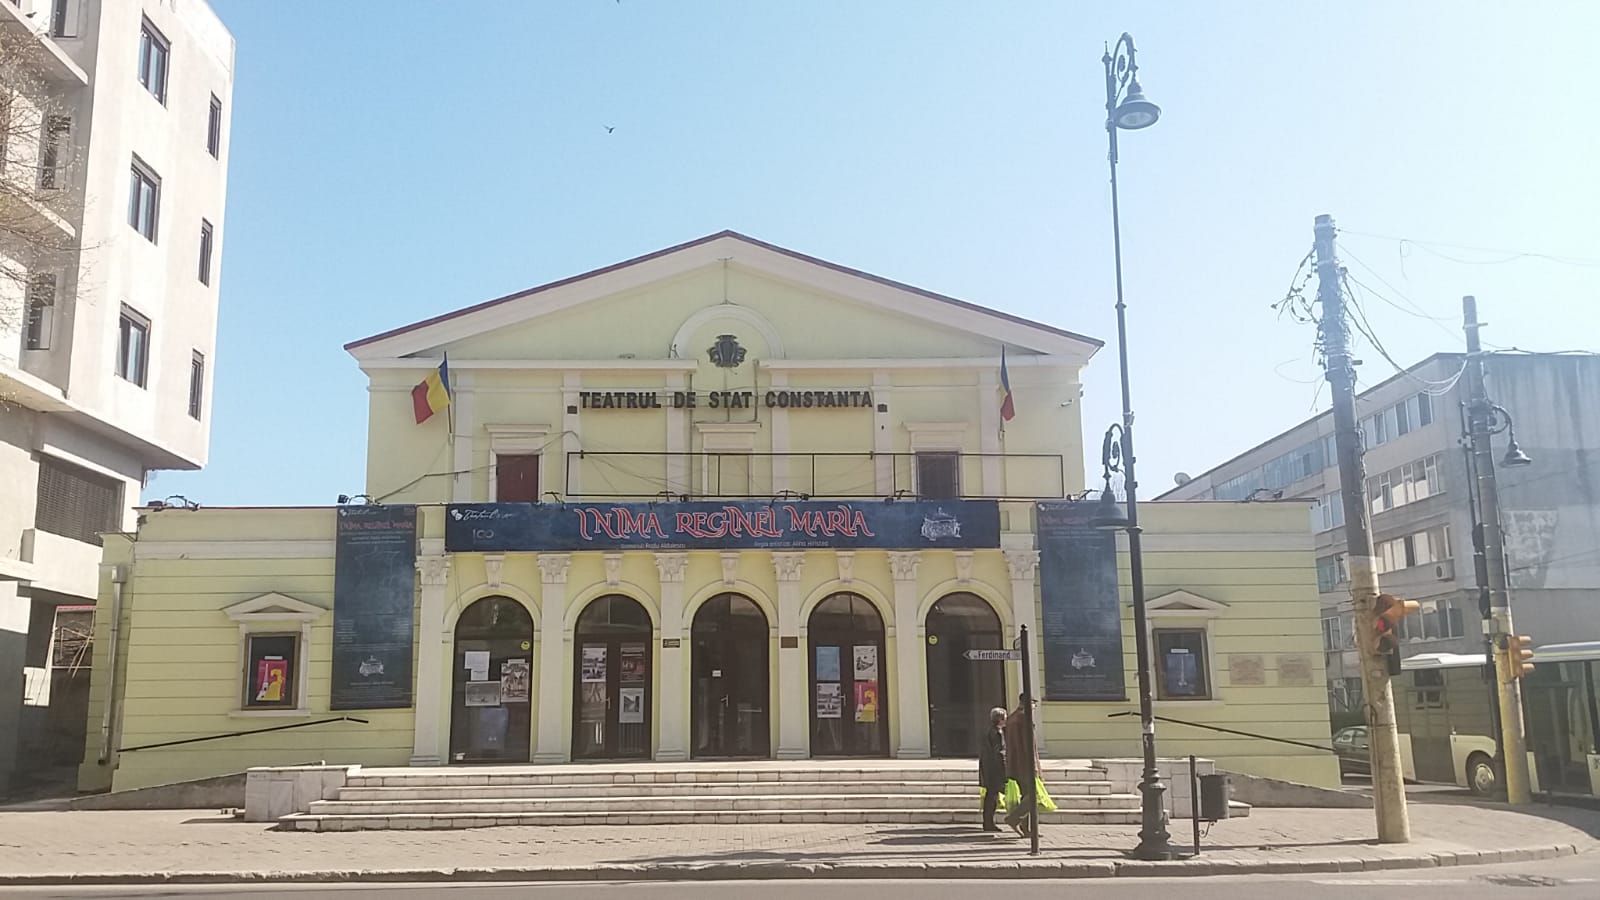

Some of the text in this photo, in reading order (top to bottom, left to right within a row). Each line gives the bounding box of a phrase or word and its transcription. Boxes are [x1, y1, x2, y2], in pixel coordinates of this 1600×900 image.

[579, 391, 872, 408] TEATRUL DE STAT CONSTANTA
[573, 505, 875, 540] INIMA REGINEI MARIA
[977, 650, 1011, 659] Ferdinand
